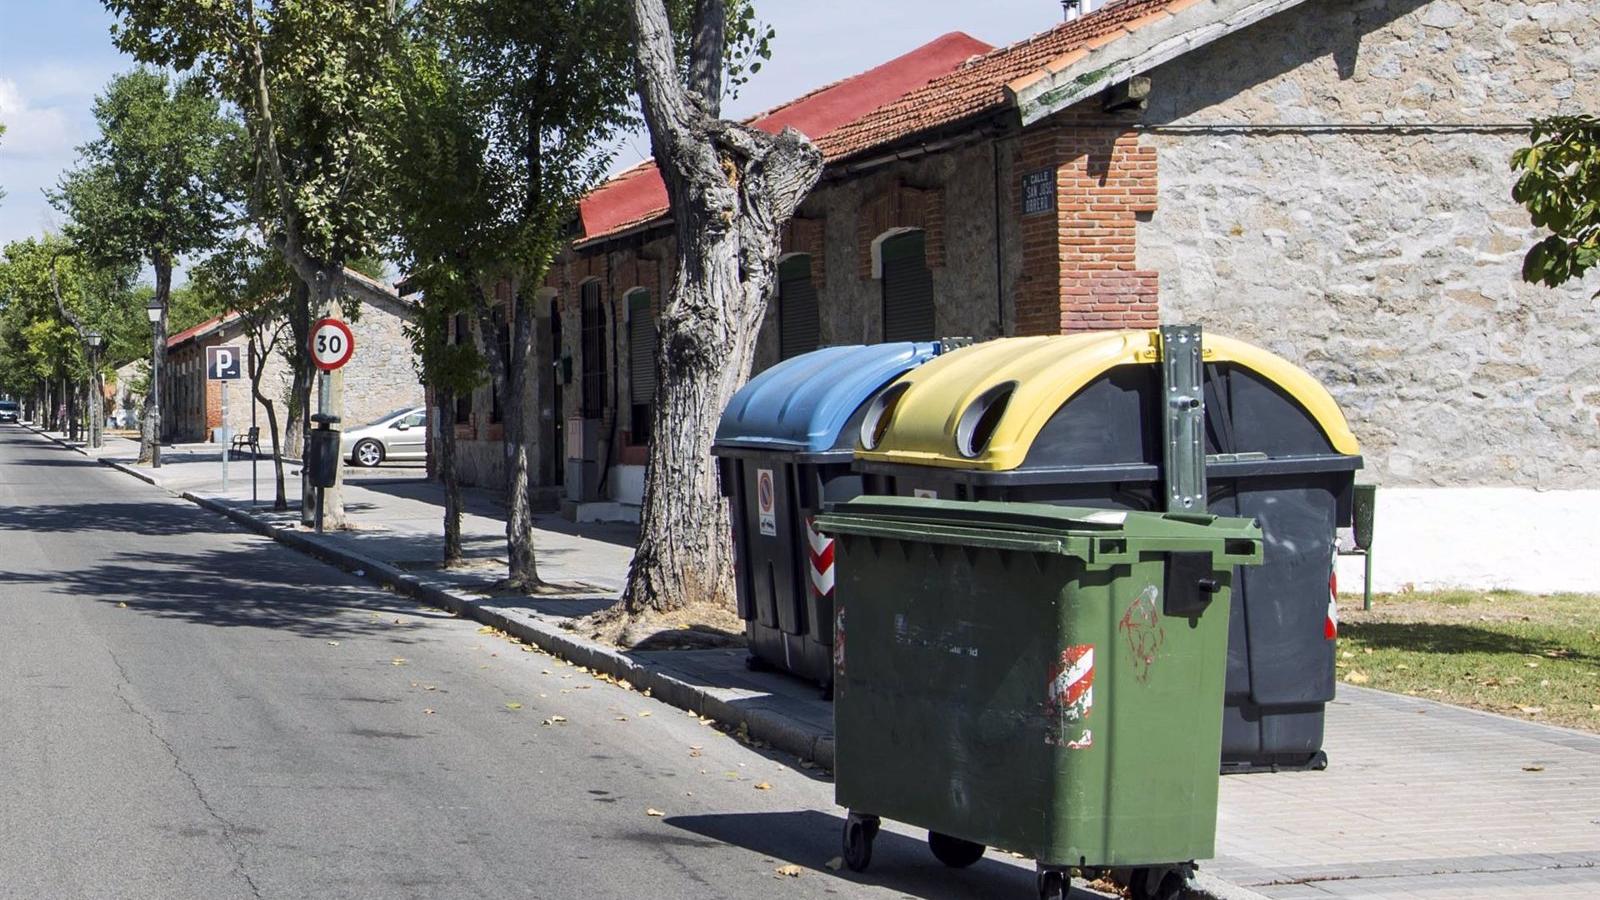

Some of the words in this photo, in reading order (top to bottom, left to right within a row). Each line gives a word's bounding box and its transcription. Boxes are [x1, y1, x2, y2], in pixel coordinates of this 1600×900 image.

[1030, 171, 1049, 184] CALLE
[1026, 185, 1038, 199] SAN
[1025, 196, 1049, 212] OBRERO
[317, 335, 342, 354] 30
[216, 349, 233, 378] P
